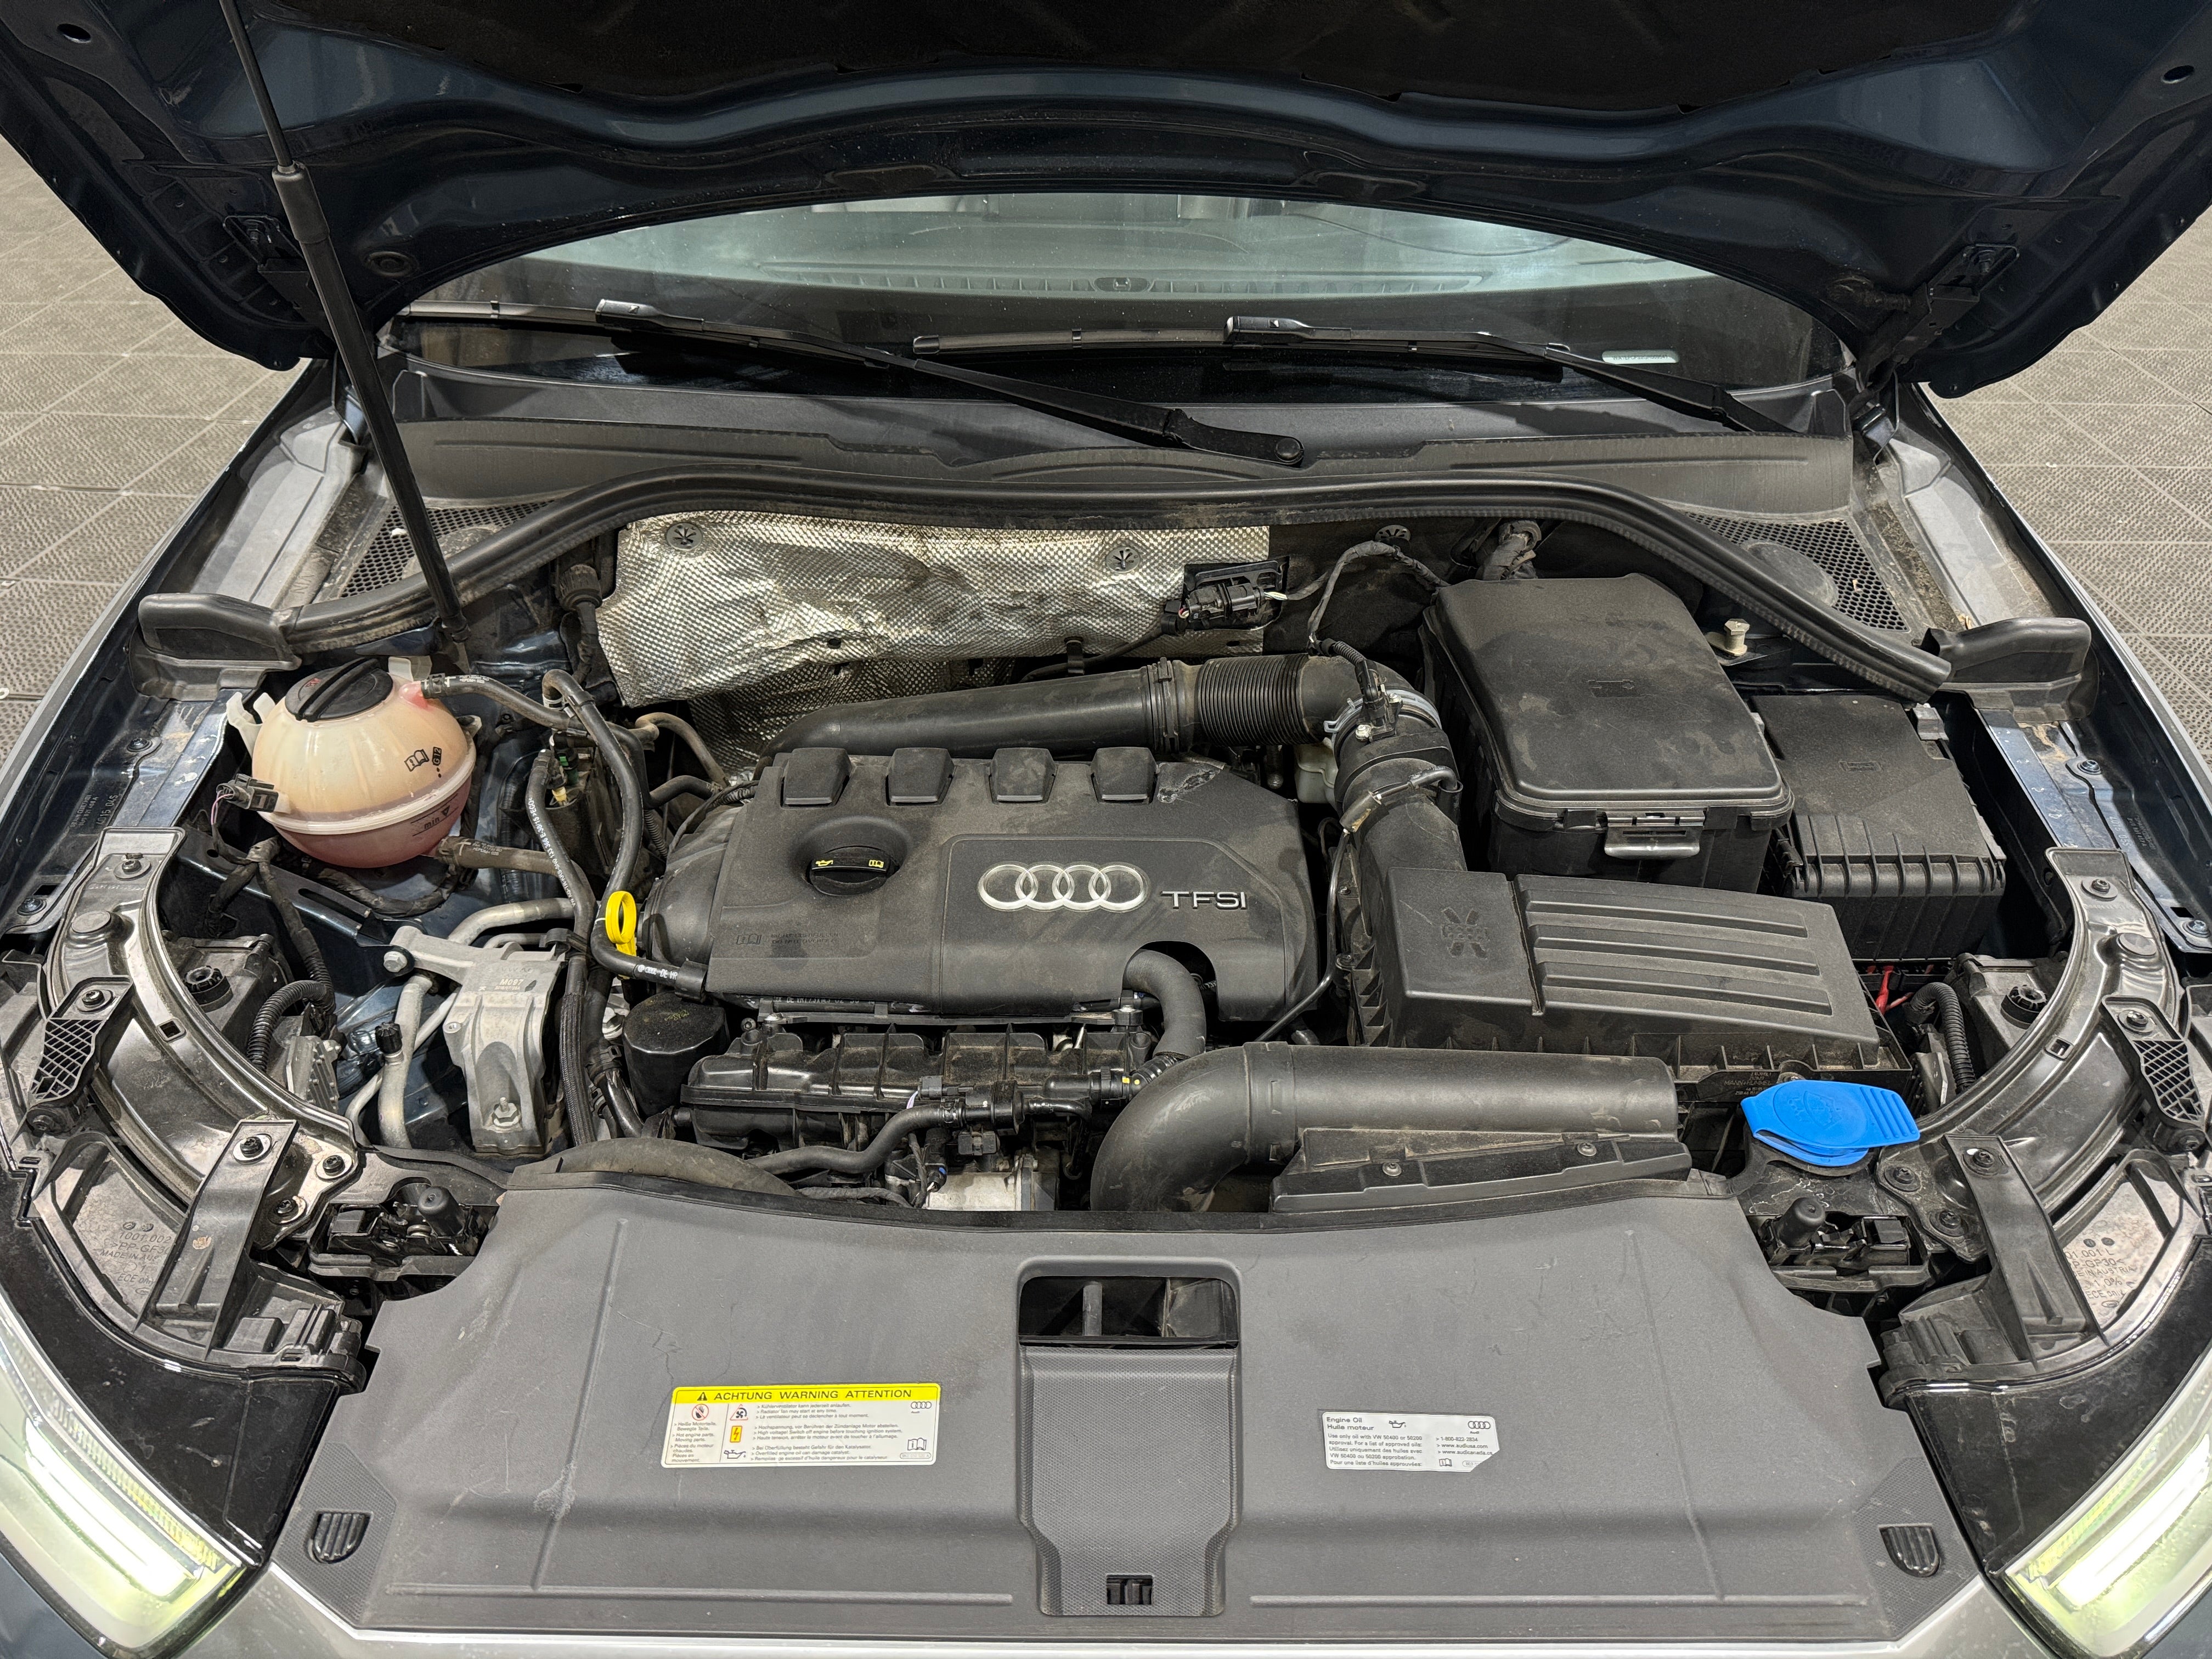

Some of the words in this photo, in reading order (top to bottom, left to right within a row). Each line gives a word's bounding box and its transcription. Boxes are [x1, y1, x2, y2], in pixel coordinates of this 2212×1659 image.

[432, 747, 441, 765] G12
[424, 816, 440, 830] min
[1160, 890, 1248, 910] TFSI
[100, 1250, 127, 1259] MADE
[2096, 1266, 2137, 1274] AUSTRIA
[117, 1273, 138, 1283] ECE
[2085, 1290, 2107, 1299] ECE
[714, 1392, 772, 1400] ACHTUNG
[779, 1391, 838, 1399] WARNING
[845, 1390, 912, 1398] ATTENTION
